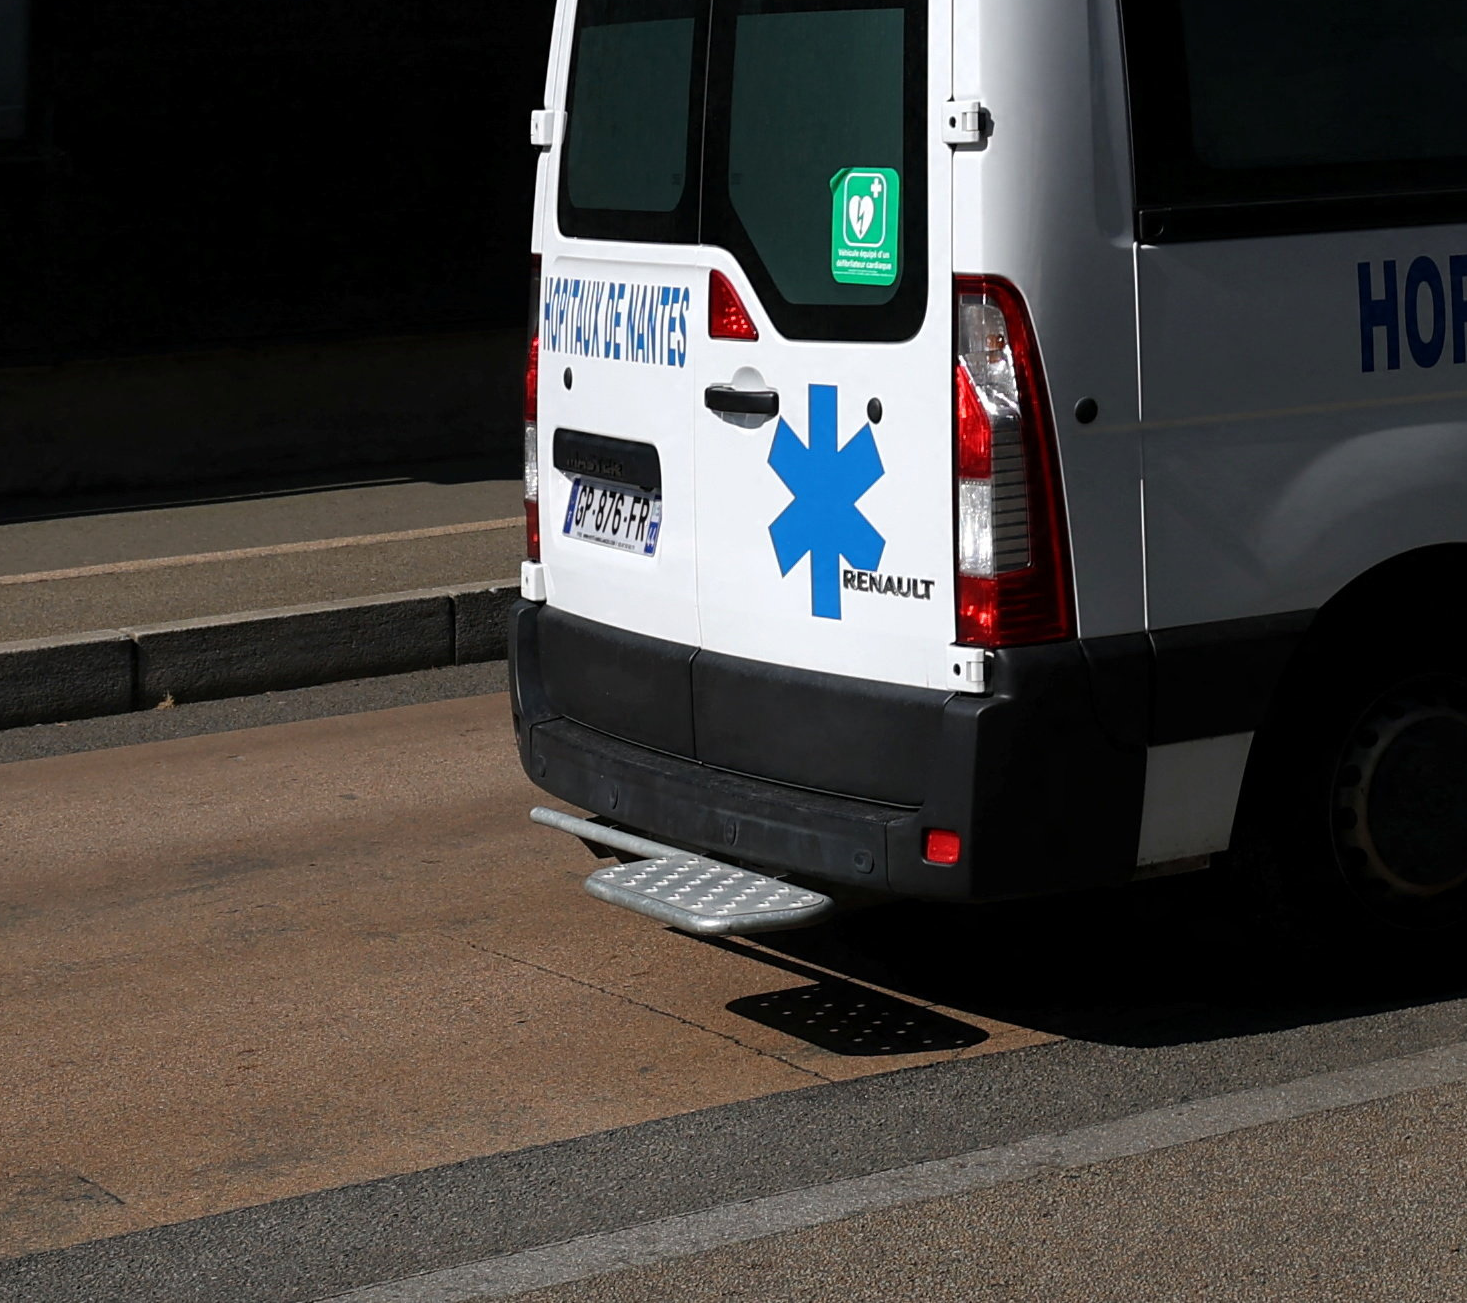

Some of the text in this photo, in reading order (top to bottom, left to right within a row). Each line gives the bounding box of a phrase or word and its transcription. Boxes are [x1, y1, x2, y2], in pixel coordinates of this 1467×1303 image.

[543, 276, 690, 368] HOPITAUX DE NANTES
[575, 485, 650, 542] GP-876-FR
[843, 569, 936, 601] RENAULT
